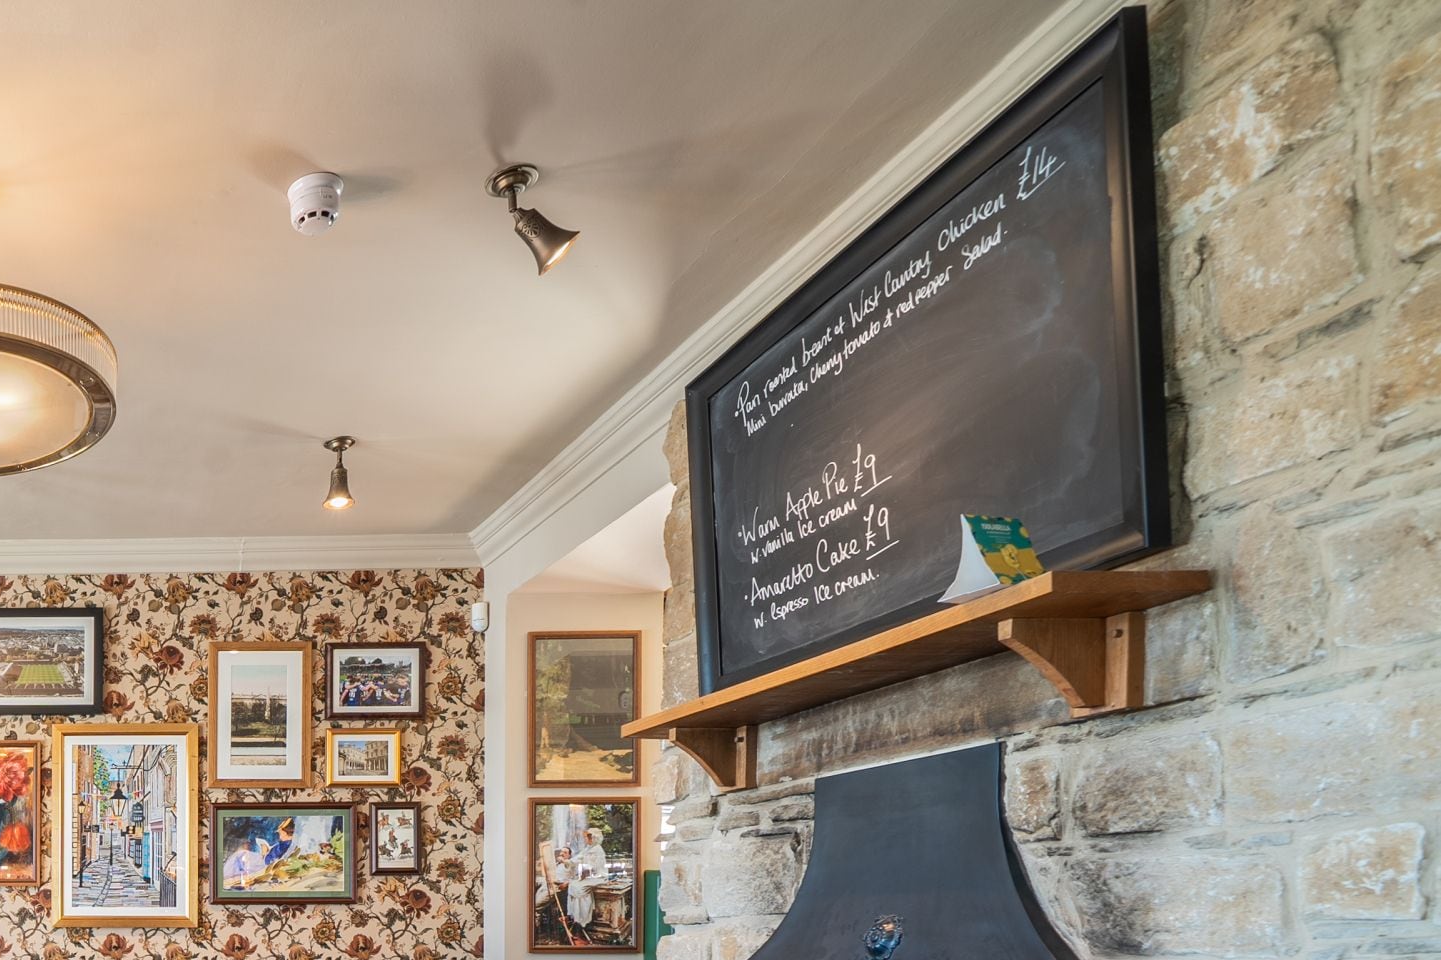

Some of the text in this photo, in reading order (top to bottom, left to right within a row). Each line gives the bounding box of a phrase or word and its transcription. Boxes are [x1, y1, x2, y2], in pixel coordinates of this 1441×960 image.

[737, 381, 761, 427] Pan
[763, 356, 798, 398] roasted
[849, 286, 882, 328] West
[937, 193, 1006, 251] Chicken
[1016, 146, 1058, 200] £14
[746, 414, 767, 437] Mini
[896, 292, 915, 318] red
[914, 266, 953, 305] pepper
[741, 443, 878, 546] Warm Apple Pie £9
[797, 520, 816, 539] Ice
[818, 498, 858, 528] cream
[750, 504, 891, 607] Amaretto Cake £9
